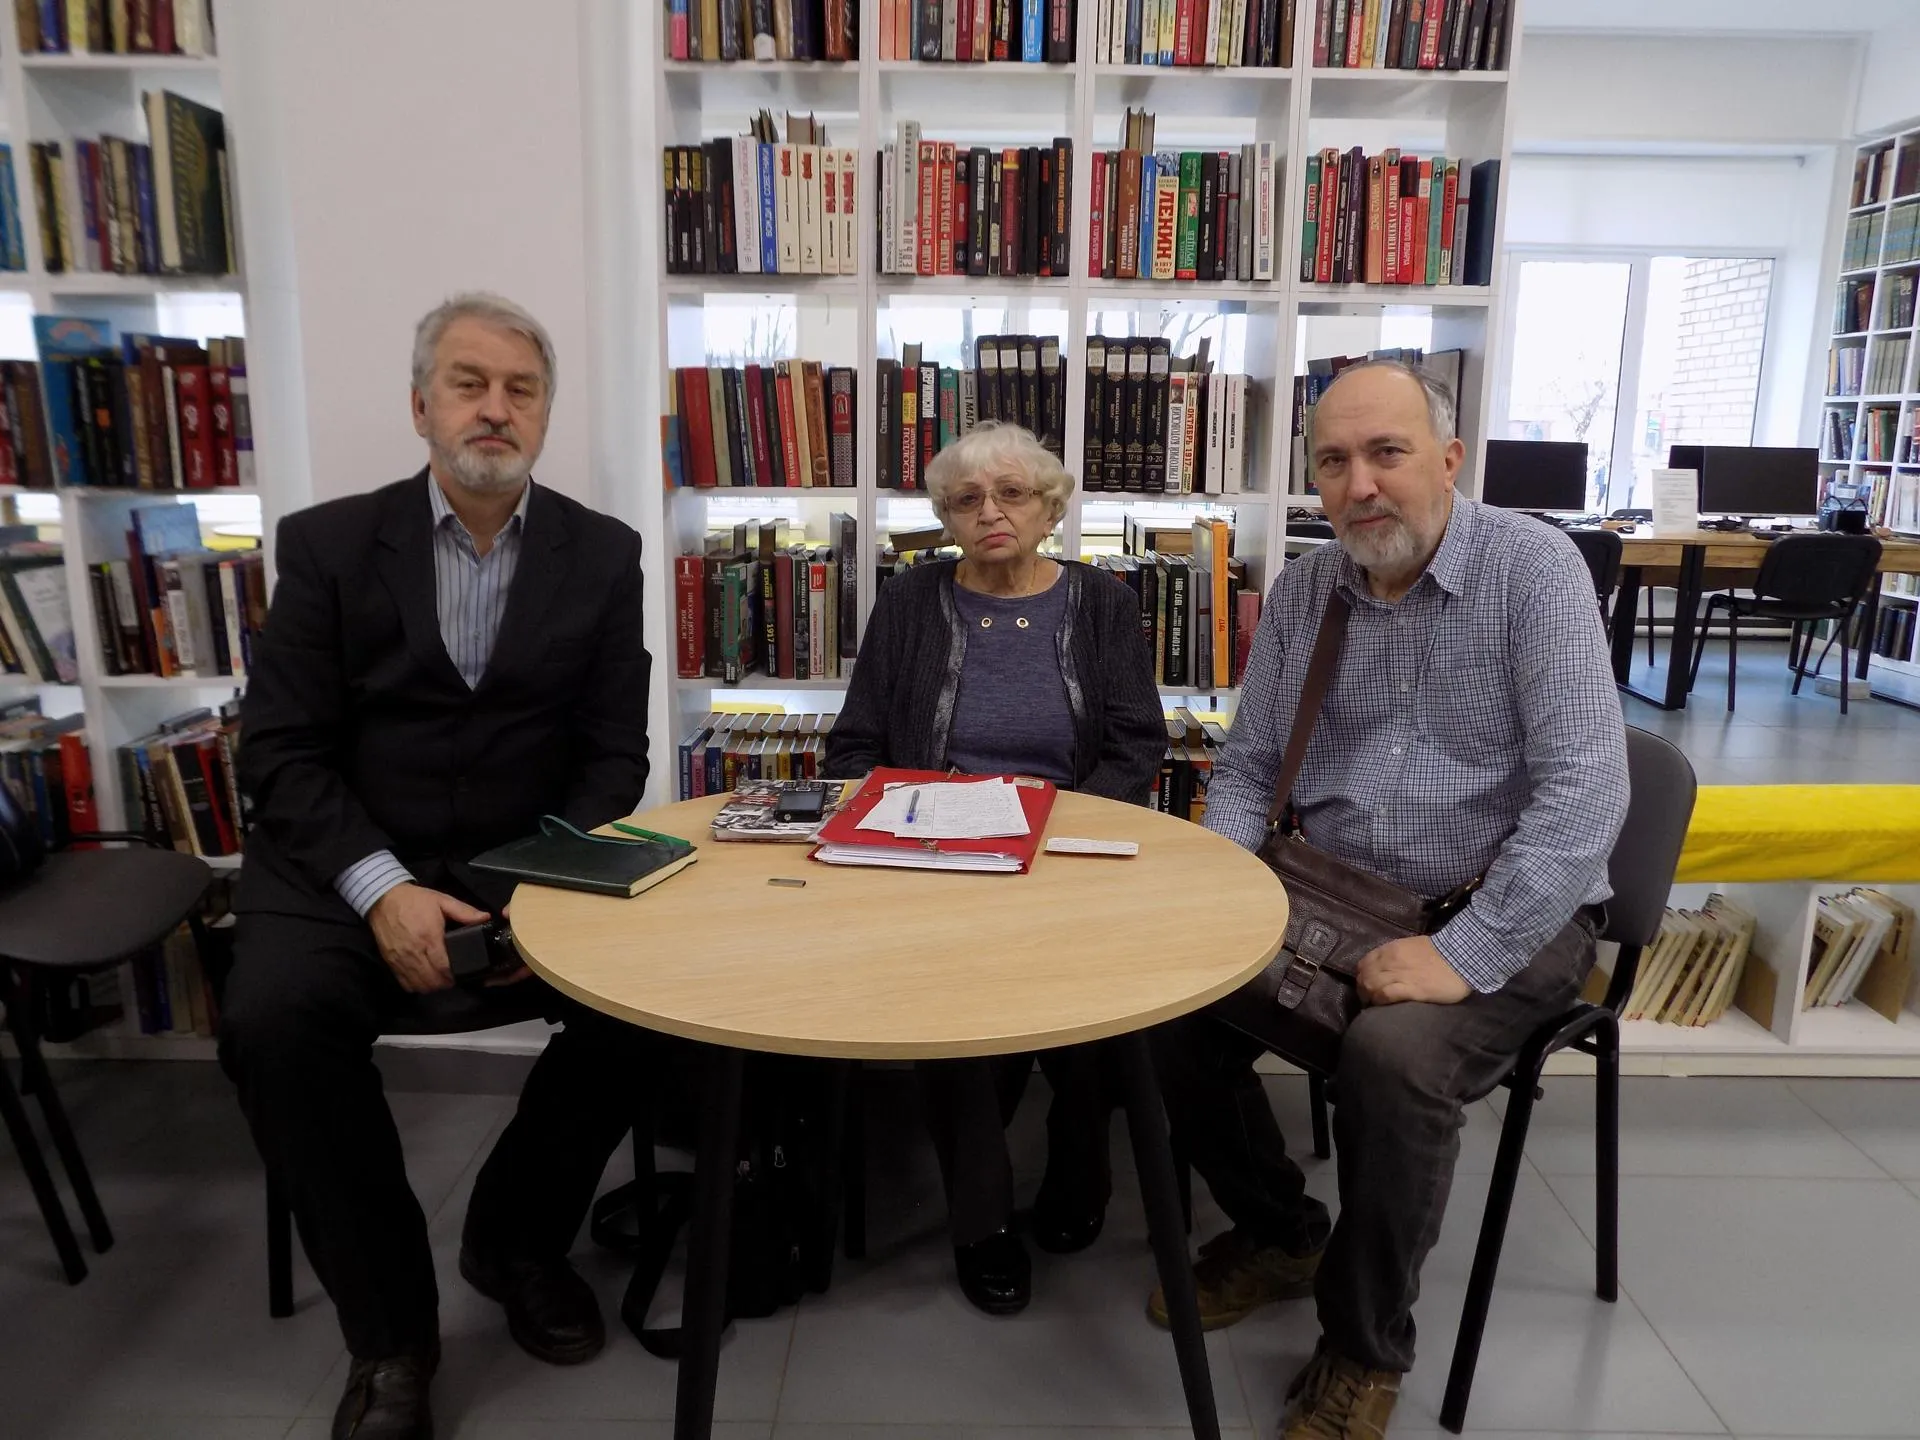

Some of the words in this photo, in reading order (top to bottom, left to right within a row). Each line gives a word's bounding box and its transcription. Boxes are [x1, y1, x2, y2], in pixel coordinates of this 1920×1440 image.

[763, 147, 771, 196] СОВЕТНИКИ
[1388, 175, 1398, 211] ЛУБЯНКИ
[765, 208, 773, 238] ВОЖДИ
[1156, 190, 1174, 259] ЛЕНИН
[1387, 218, 1396, 250] ГЕНСЕКА
[806, 246, 813, 258] 2
[903, 220, 913, 268] ЕЛЬЦИН
[1186, 230, 1195, 267] ХРУЩЕВ
[1386, 251, 1395, 271] ТАЙН
[1170, 406, 1181, 445] КОТОВСКИЙ
[1186, 408, 1195, 443] ОКТЯБРЬ
[902, 427, 910, 481] ПОДЛОСТЬ
[1169, 447, 1180, 480] ГРИГОРИЙ
[683, 560, 689, 575] 1
[1174, 577, 1183, 606] 1917-1991
[767, 623, 775, 642] 1917
[1218, 618, 1226, 632] 1917
[1172, 627, 1180, 656] ИСТОРИЯ
